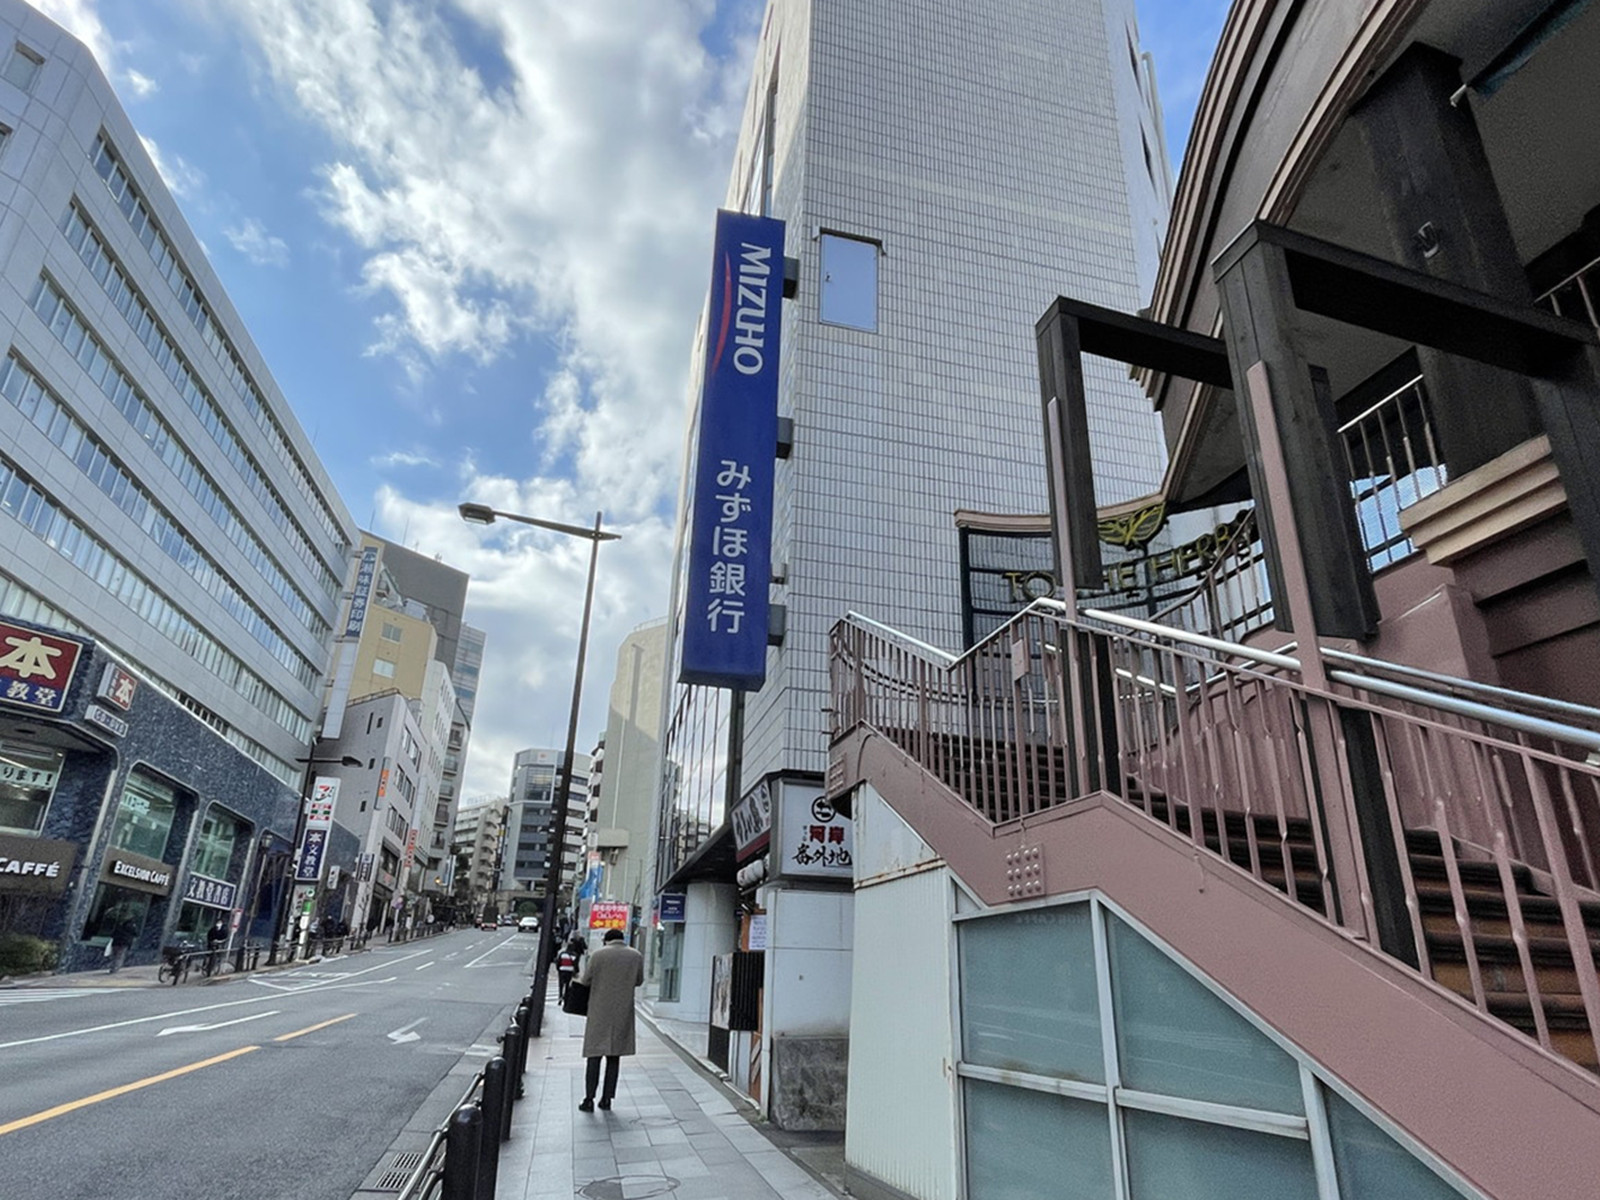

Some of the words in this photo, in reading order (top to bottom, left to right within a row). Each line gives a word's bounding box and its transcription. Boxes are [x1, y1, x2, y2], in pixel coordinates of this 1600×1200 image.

[733, 242, 771, 375] MIZUHO
[707, 460, 752, 634] みずほ銀行
[1001, 571, 1057, 602] TO
[0, 636, 62, 679] 本
[792, 844, 853, 867] 番外地
